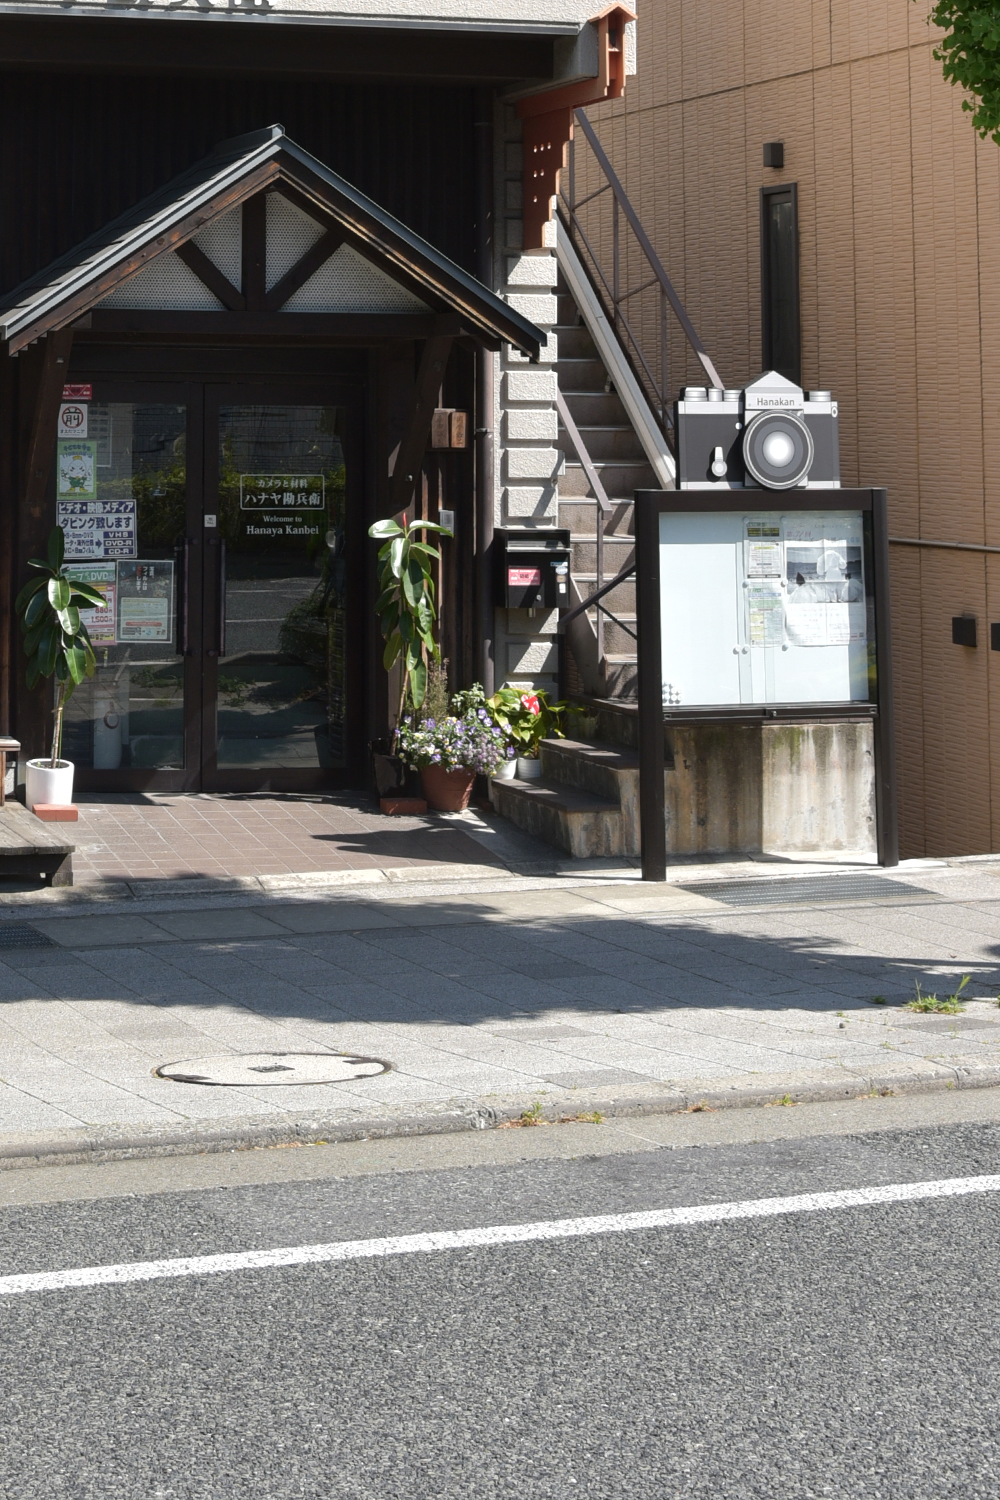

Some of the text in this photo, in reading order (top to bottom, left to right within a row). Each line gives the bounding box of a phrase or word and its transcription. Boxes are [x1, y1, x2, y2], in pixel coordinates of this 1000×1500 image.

[757, 397, 795, 406] Hanakan
[258, 478, 308, 488] カメラと材料
[245, 492, 320, 505] ハナヤ勘兵衛
[61, 516, 132, 529] ダビング致します
[246, 525, 319, 537] Hanaya Kanbei
